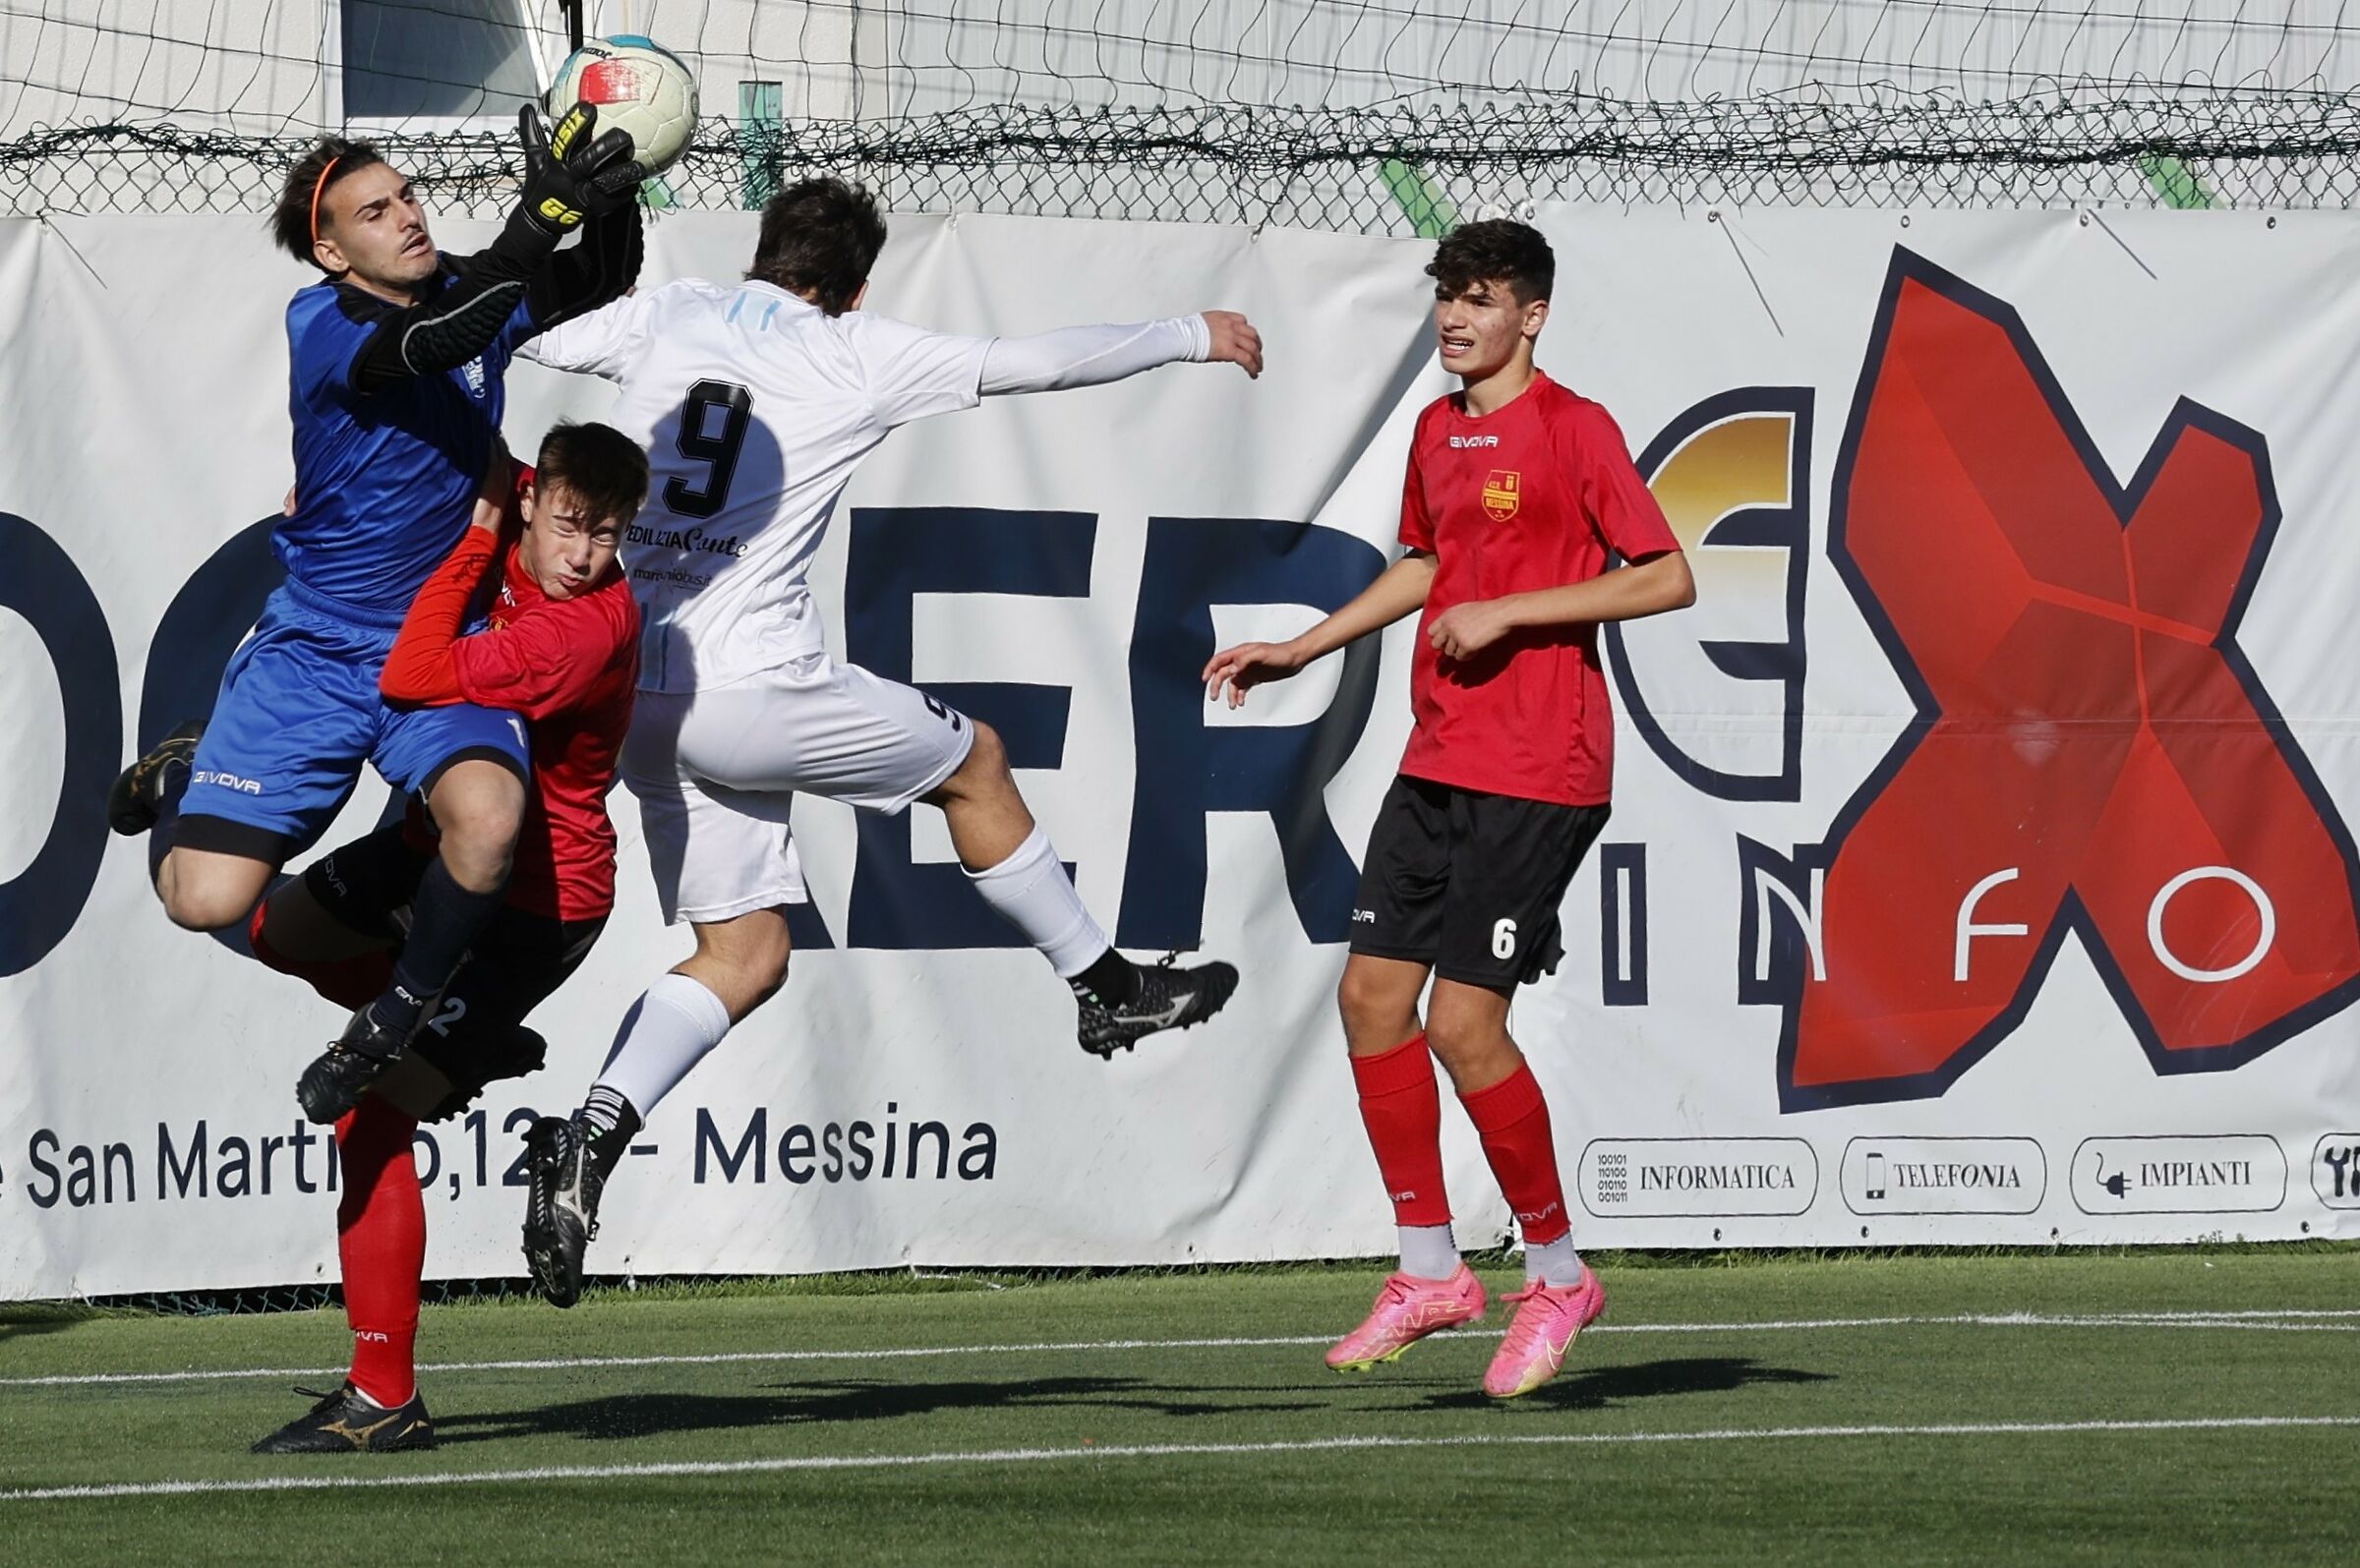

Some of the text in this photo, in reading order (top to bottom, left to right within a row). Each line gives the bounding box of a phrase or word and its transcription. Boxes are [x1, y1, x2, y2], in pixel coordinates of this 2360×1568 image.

[662, 377, 754, 519] 9
[1449, 436, 1499, 447] GIVOVA
[506, 719, 525, 748] 1
[193, 771, 262, 795] GIVOVA
[1601, 834, 2276, 1006] INFO
[1492, 918, 1517, 959] 6
[428, 997, 466, 1037] 2
[27, 1129, 136, 1209] San
[693, 1101, 997, 1185] Messina
[1597, 1154, 1627, 1166] 100101
[1597, 1167, 1627, 1178] 110100
[1597, 1179, 1627, 1191] 010110
[1639, 1164, 1796, 1191] INFORMATICA
[1894, 1163, 2021, 1189] TELEFONIA
[2141, 1161, 2251, 1187] IMPIANTI
[1597, 1191, 1628, 1203] 001011
